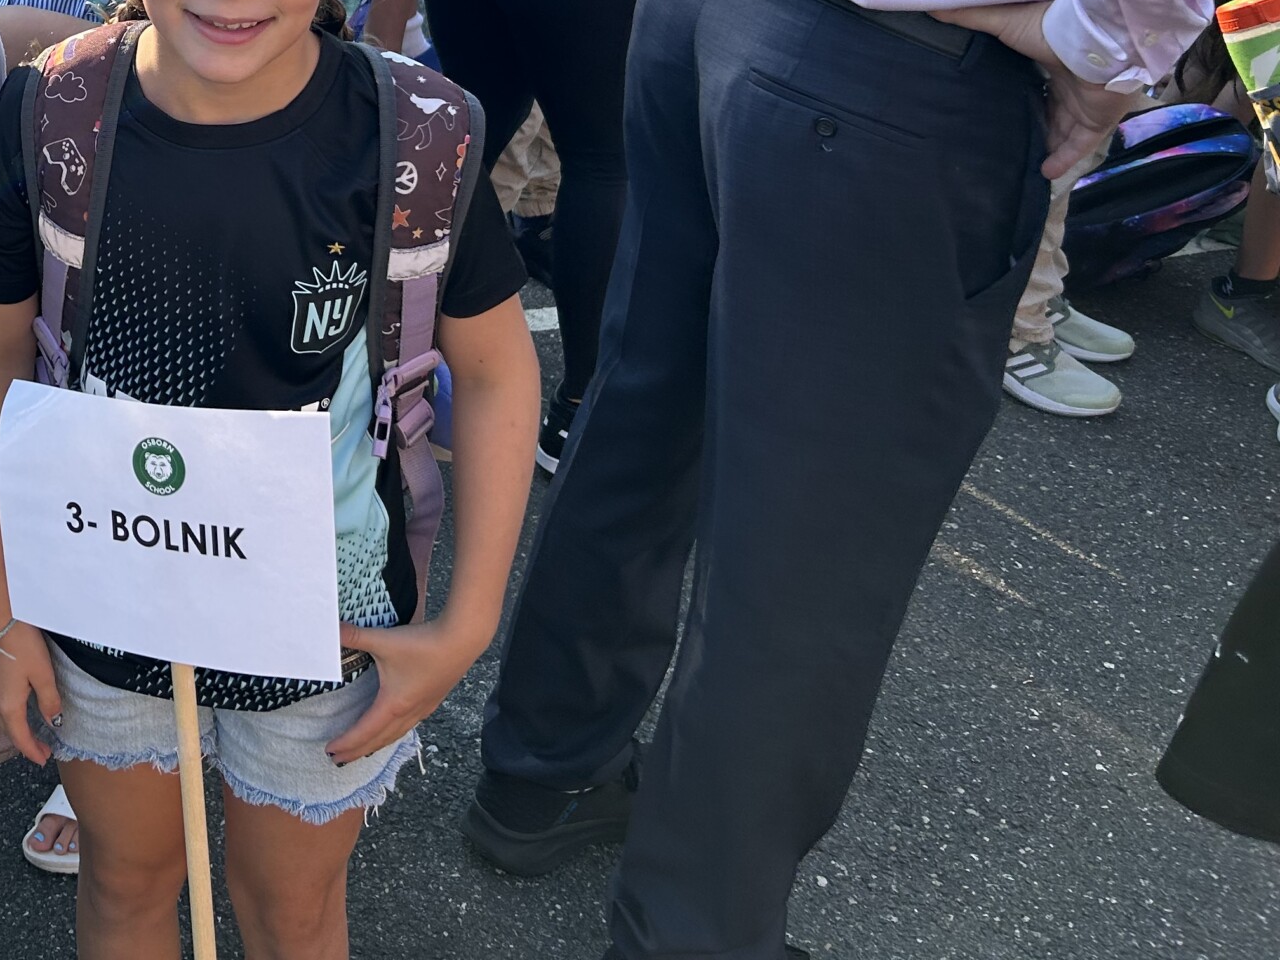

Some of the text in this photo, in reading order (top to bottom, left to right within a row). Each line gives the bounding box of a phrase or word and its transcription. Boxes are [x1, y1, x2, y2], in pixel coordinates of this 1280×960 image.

[303, 295, 353, 343] NY
[141, 439, 174, 454] OSBORN
[145, 481, 175, 495] SCHOOL
[111, 509, 247, 560] BOLNIK
